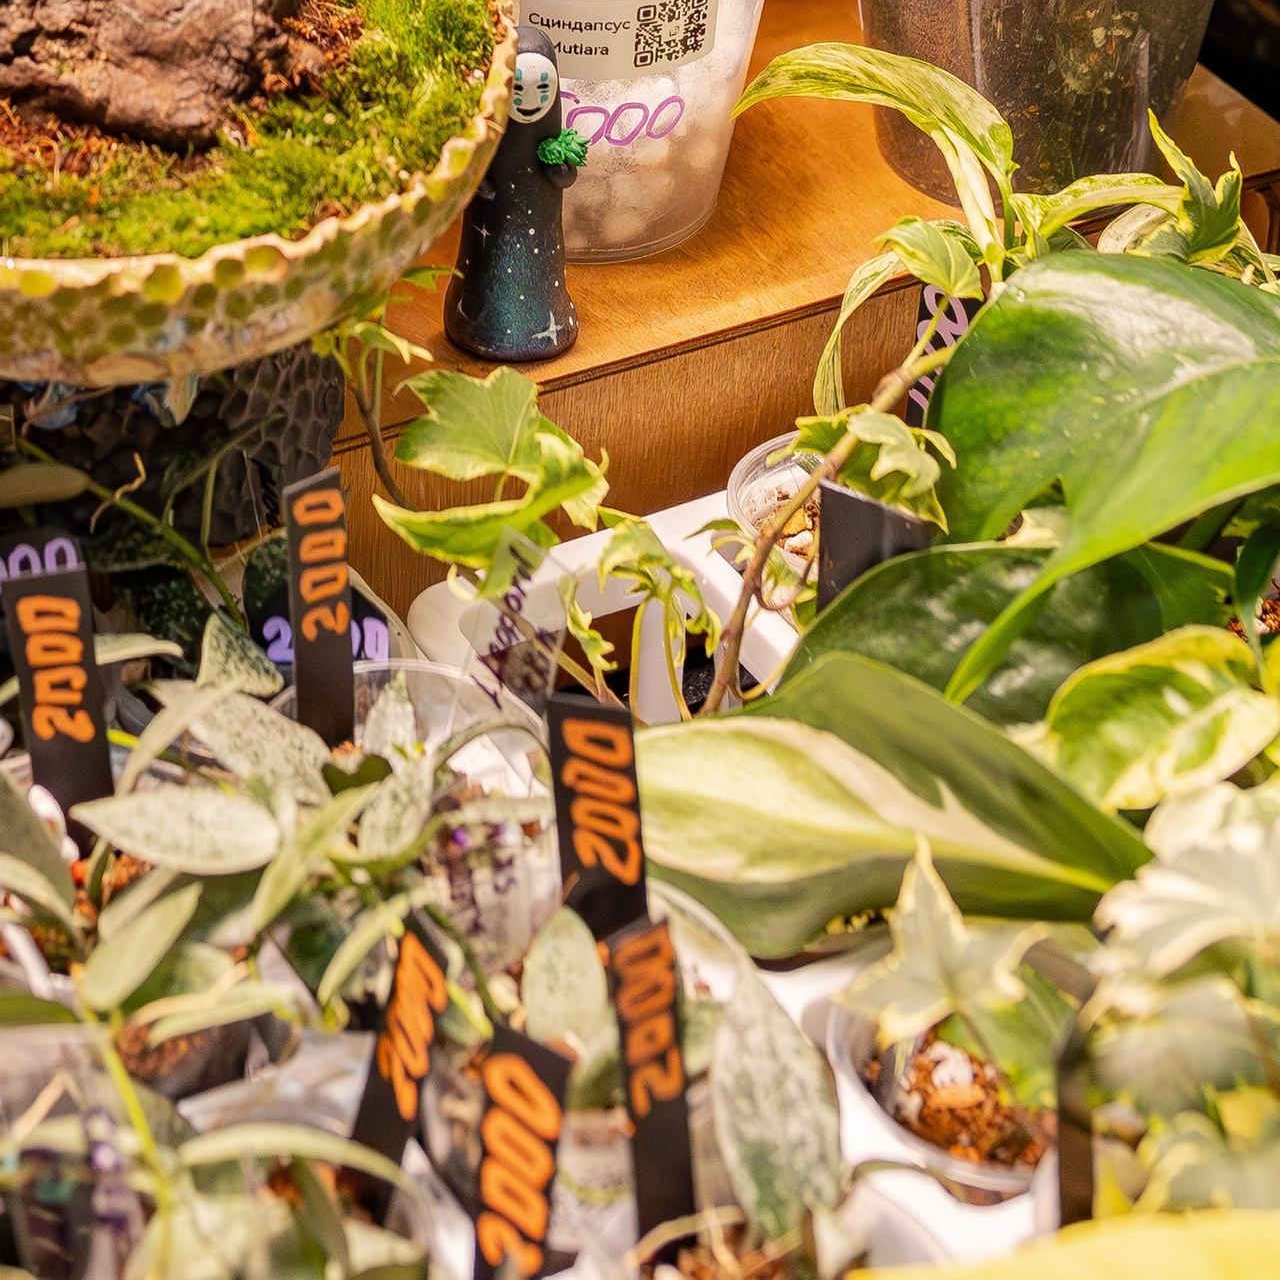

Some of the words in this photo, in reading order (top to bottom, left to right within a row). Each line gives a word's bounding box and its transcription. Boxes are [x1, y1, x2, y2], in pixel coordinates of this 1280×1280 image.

[528, 12, 631, 33] Сциндапсус
[291, 489, 351, 643] 2000
[15, 595, 96, 743] 2000
[561, 718, 642, 887] 2000
